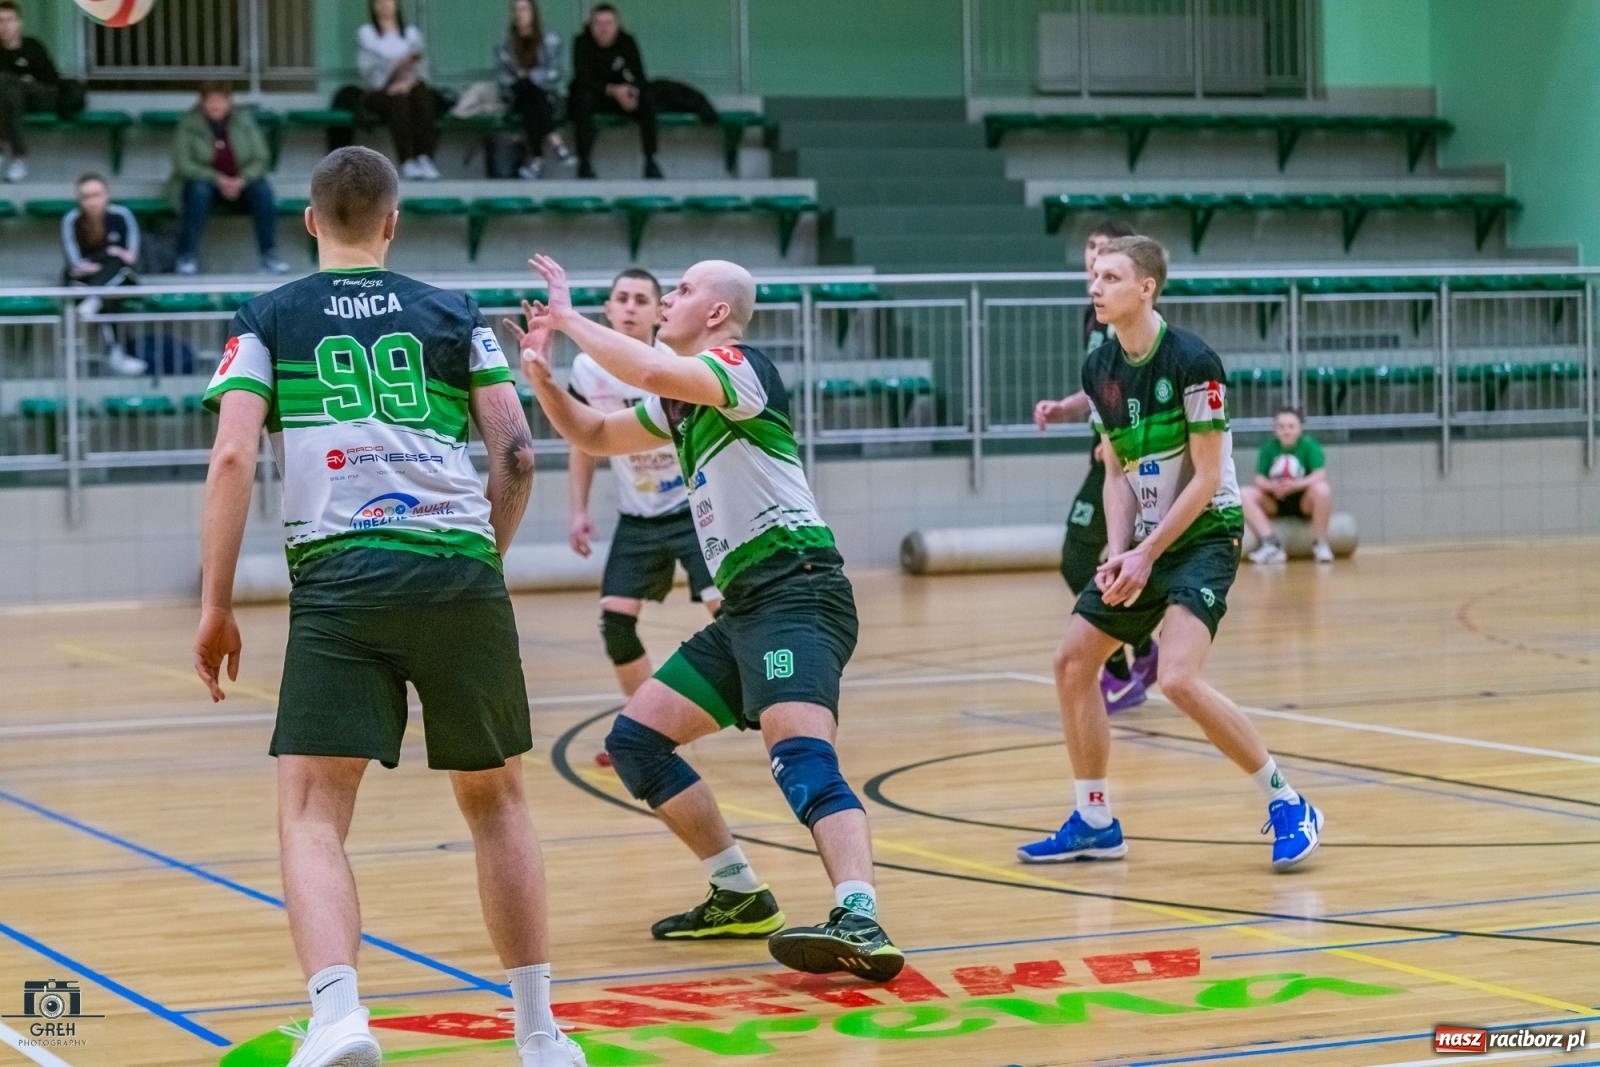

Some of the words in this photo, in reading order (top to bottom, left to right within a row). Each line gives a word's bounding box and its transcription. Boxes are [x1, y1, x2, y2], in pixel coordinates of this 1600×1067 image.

[323, 292, 403, 320] JOŃCA
[314, 332, 431, 423] 99
[1127, 398, 1141, 429] 3
[347, 452, 443, 466] VANESSA
[411, 501, 451, 515] MULTI
[763, 649, 794, 681] 19
